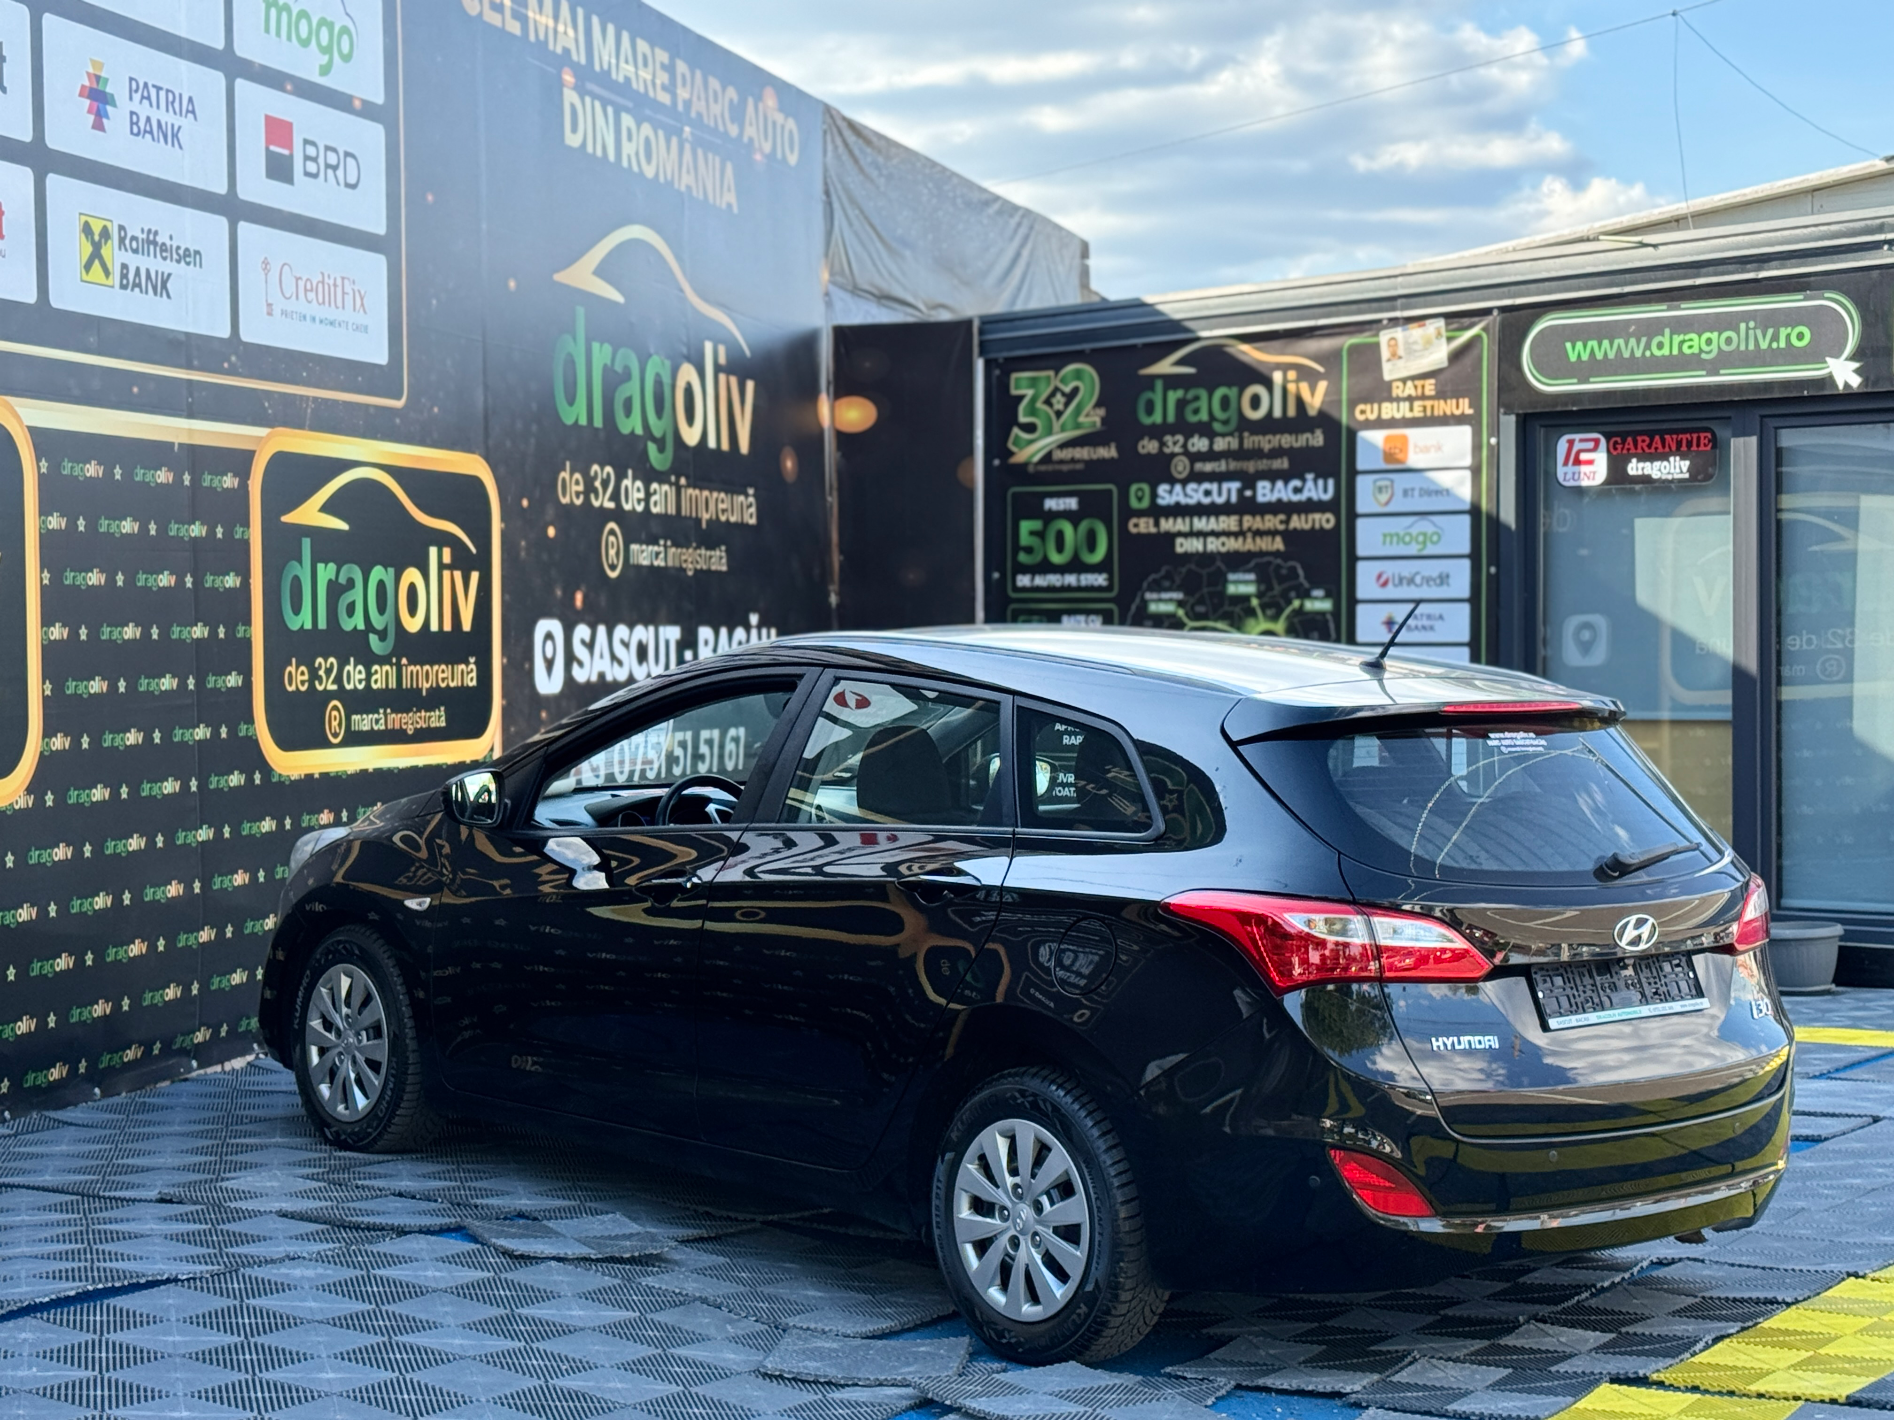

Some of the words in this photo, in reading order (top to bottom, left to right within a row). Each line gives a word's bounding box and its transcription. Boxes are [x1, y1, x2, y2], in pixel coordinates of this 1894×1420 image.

[262, 0, 355, 78] mogo
[128, 75, 198, 122] PATRIA
[527, 0, 587, 66] MAI
[591, 14, 672, 107] MARE
[675, 58, 739, 139] PARC
[742, 95, 800, 167] AUTO
[129, 110, 184, 151] BANK
[301, 138, 361, 190] BRD
[563, 86, 614, 163] DIN
[621, 111, 739, 214] ROMÂNIA
[117, 223, 203, 269] Raiffeisen
[119, 262, 173, 301] BANK
[278, 262, 368, 315] CreditFix
[1565, 321, 1811, 362] www.dragoliv.ro
[553, 305, 755, 472] dragoliv
[1136, 370, 1329, 434] dragoliv
[1391, 379, 1436, 397] RATE
[1354, 403, 1379, 421] CU
[1380, 398, 1474, 420] BULETINUL
[1137, 437, 1160, 455] de
[1162, 434, 1185, 454] 32
[1187, 433, 1210, 453] de
[1212, 432, 1239, 451] ani
[1242, 428, 1325, 453] împreună
[1413, 443, 1444, 455] bank
[1562, 437, 1602, 467] 12
[1608, 432, 1713, 455] GARANTIE
[60, 458, 105, 481] dragoliv
[133, 465, 174, 487] dragoliv
[201, 470, 240, 492] dragoliv
[1563, 471, 1597, 482] LUNI
[1627, 456, 1690, 479] dragoliv
[557, 460, 585, 506] de
[590, 463, 616, 509] 32
[620, 468, 645, 514] de
[649, 475, 676, 517] ani
[680, 476, 757, 529] împreună
[1155, 481, 1242, 506] SASCUT
[1255, 473, 1335, 504] BACĂU
[98, 515, 140, 537] dragoliv
[167, 519, 208, 541] dragoliv
[1017, 518, 1109, 566] 500
[1127, 517, 1157, 534] CEL
[1159, 516, 1191, 533] MAI
[1192, 514, 1240, 532] MARE
[1242, 513, 1287, 532] PARC
[1288, 512, 1336, 531] AUTO
[1381, 531, 1441, 553] mogo
[629, 538, 665, 567] marcă
[666, 540, 728, 576] înregistrată
[1174, 536, 1204, 554] DIN
[1206, 532, 1286, 553] ROMÂNIA
[62, 567, 107, 590] dragoliv
[135, 570, 177, 591] dragoliv
[203, 571, 242, 592] dragoliv
[280, 537, 480, 656] dragoliv
[1391, 571, 1451, 588] UniCredit
[99, 622, 142, 644] dragoliv
[169, 621, 210, 643] dragoliv
[571, 623, 681, 683] SASCUT
[64, 675, 109, 698] dragoliv
[137, 673, 179, 695] dragoliv
[205, 670, 244, 692] dragoliv
[284, 657, 309, 692] de
[314, 656, 338, 692] 32
[343, 656, 366, 691] de
[370, 656, 397, 690] ani
[401, 656, 477, 697] împreună
[101, 727, 145, 750] dragoliv
[172, 722, 212, 745] dragoliv
[351, 708, 385, 731] marcă
[386, 706, 446, 735] înregistrată
[672, 730, 693, 777] 51
[697, 728, 720, 774] 51
[724, 726, 746, 772] 61
[66, 782, 111, 806] dragoliv
[139, 776, 181, 798] dragoliv
[207, 769, 246, 790] dragoliv
[27, 842, 74, 867] dragoliv
[103, 833, 147, 856] dragoliv
[174, 823, 215, 846] dragoliv
[240, 816, 277, 837] dragoliv
[301, 808, 335, 829] dragoliv
[69, 891, 113, 915] dragoliv
[142, 879, 185, 903] dragoliv
[211, 868, 250, 891] dragoliv
[28, 952, 76, 977] dragoliv
[104, 941, 148, 963] dragoliv
[176, 928, 217, 950] dragoliv
[68, 999, 113, 1024] dragoliv
[141, 982, 183, 1007] dragoliv
[209, 967, 249, 991] dragoliv
[1430, 1035, 1500, 1052] HYUNDAI
[22, 1061, 70, 1088] dragoliv
